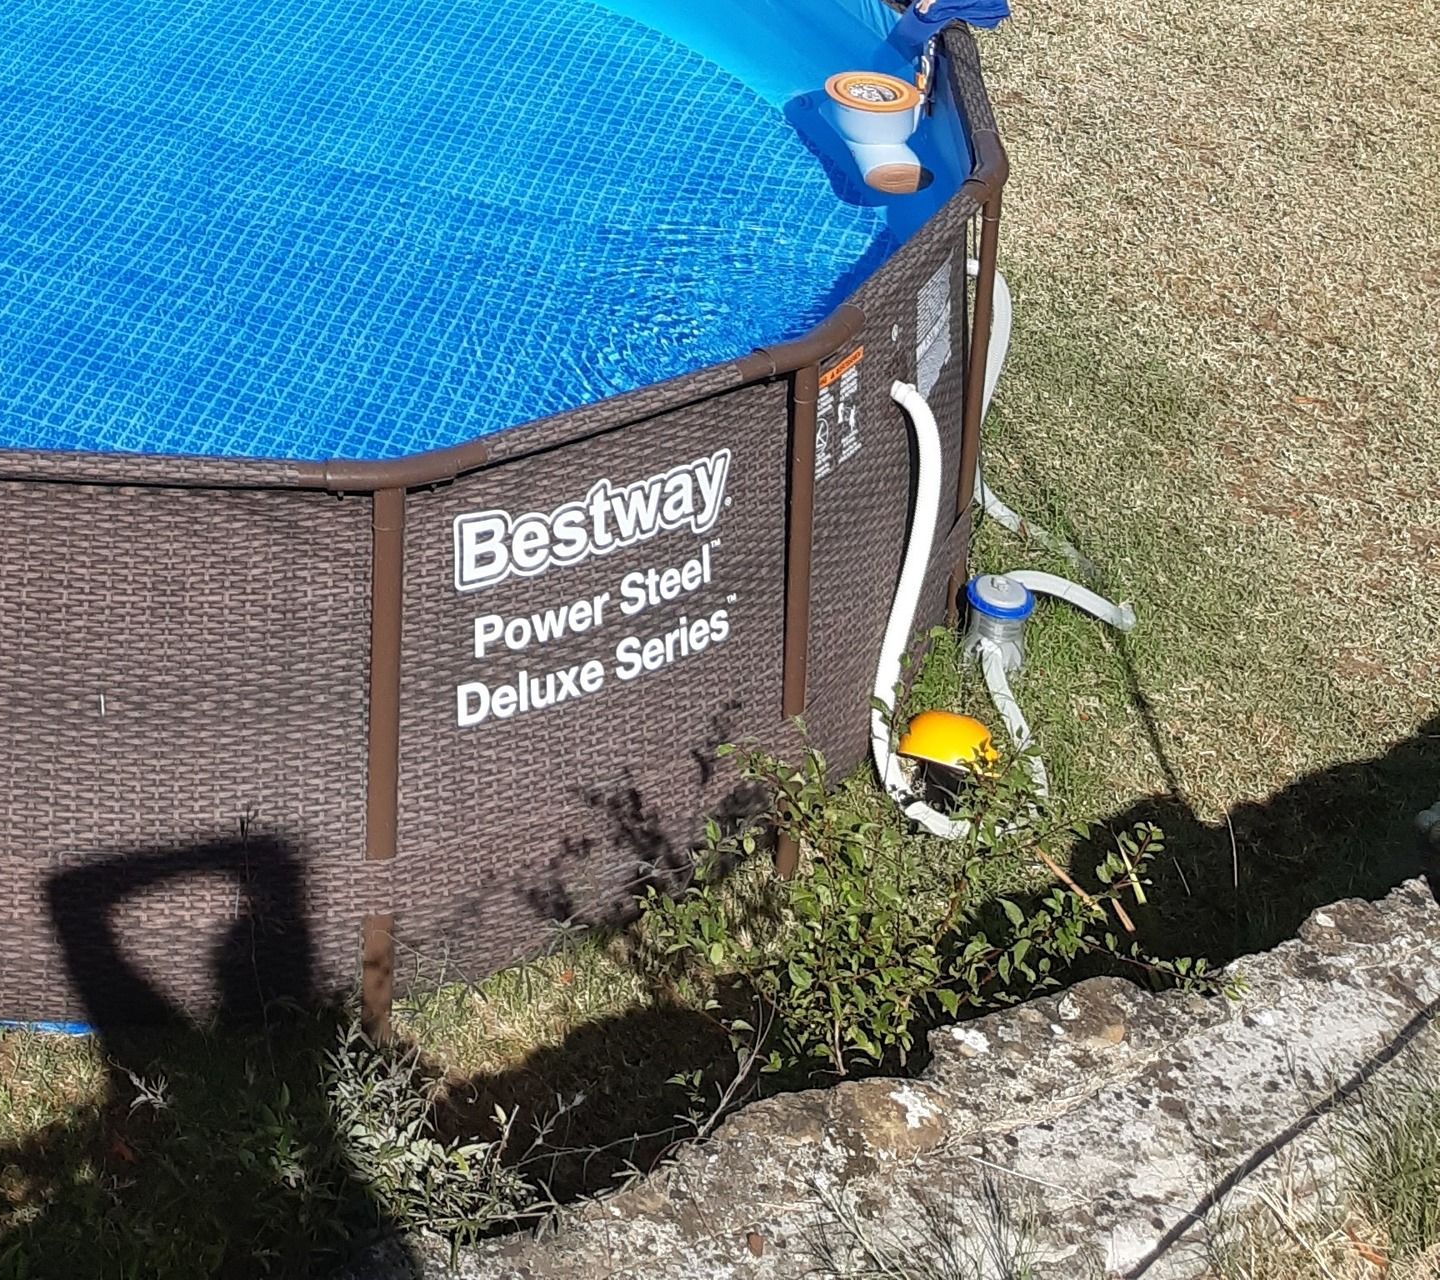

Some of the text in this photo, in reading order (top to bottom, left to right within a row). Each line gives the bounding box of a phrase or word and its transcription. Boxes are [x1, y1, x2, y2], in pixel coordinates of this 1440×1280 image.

[454, 448, 731, 590] Bestway
[474, 591, 610, 658] Power
[619, 543, 711, 615] Steel
[456, 660, 604, 727] Deluxe
[615, 609, 729, 680] Series
